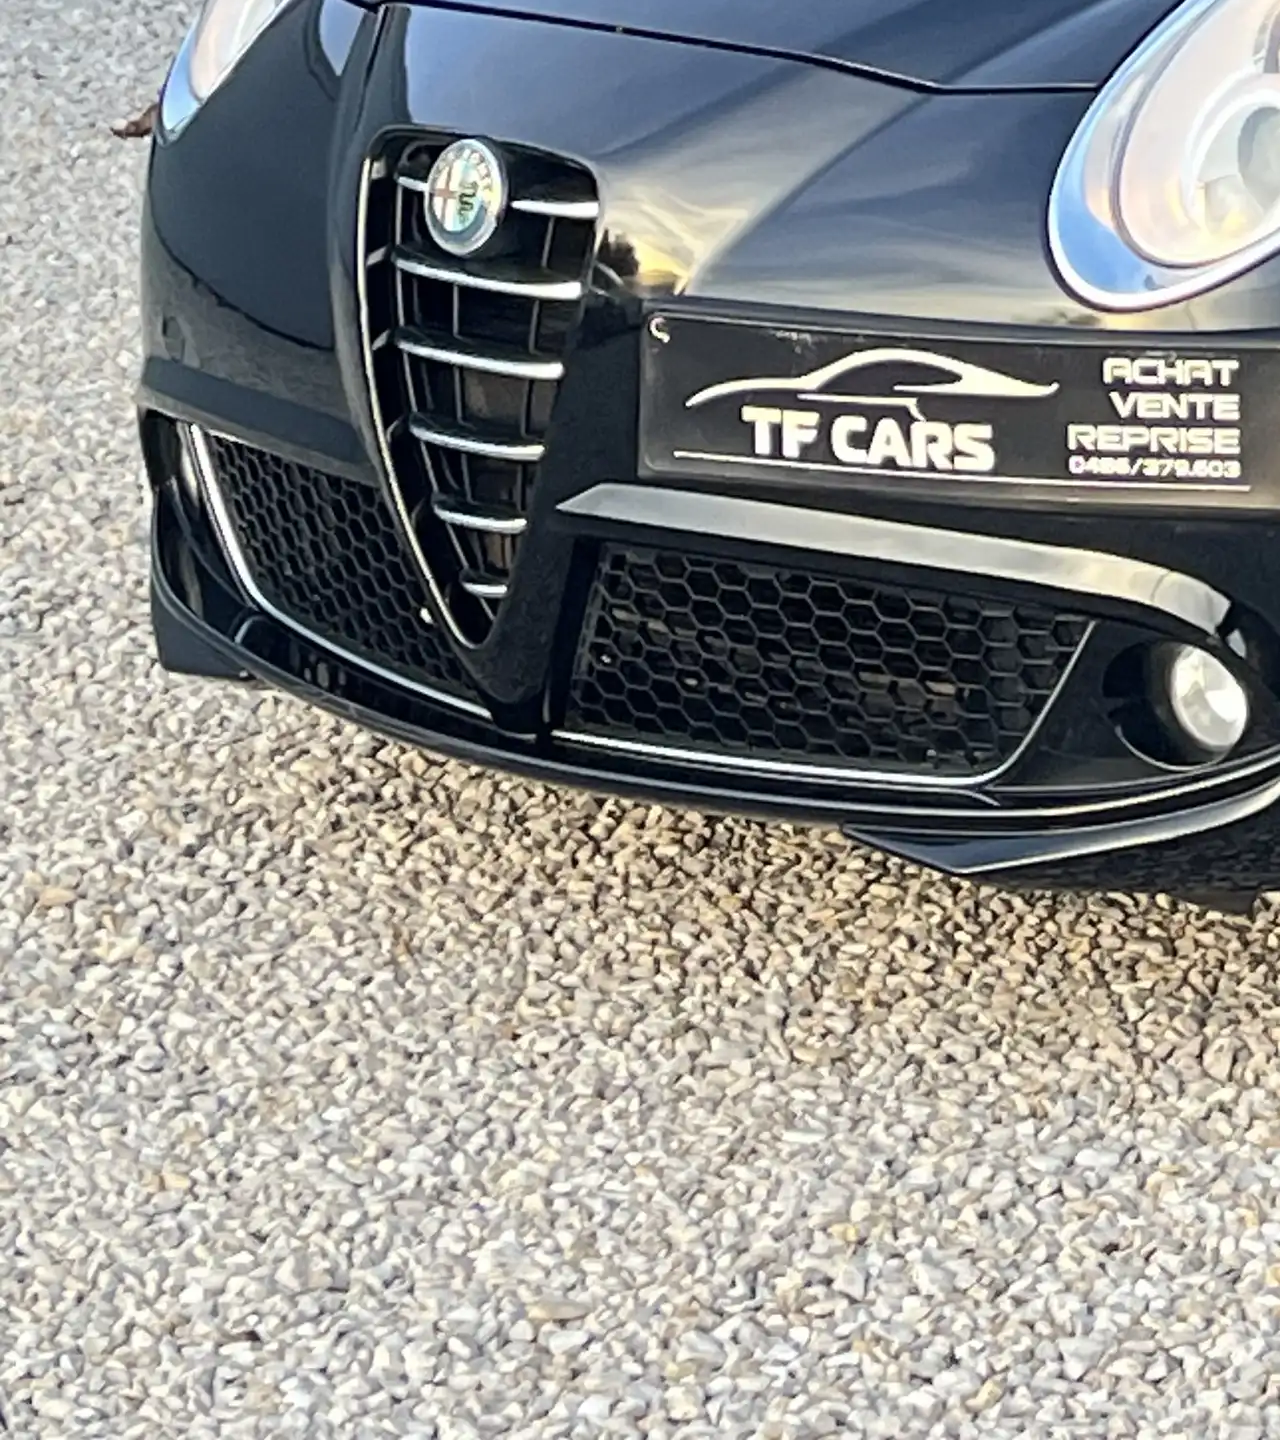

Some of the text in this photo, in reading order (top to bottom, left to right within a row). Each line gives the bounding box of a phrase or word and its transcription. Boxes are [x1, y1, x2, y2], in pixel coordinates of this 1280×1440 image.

[1103, 357, 1240, 387] ACHAT
[1109, 391, 1241, 421] VENTE
[741, 405, 995, 472] TF CARS
[1067, 424, 1241, 455] REPRISE
